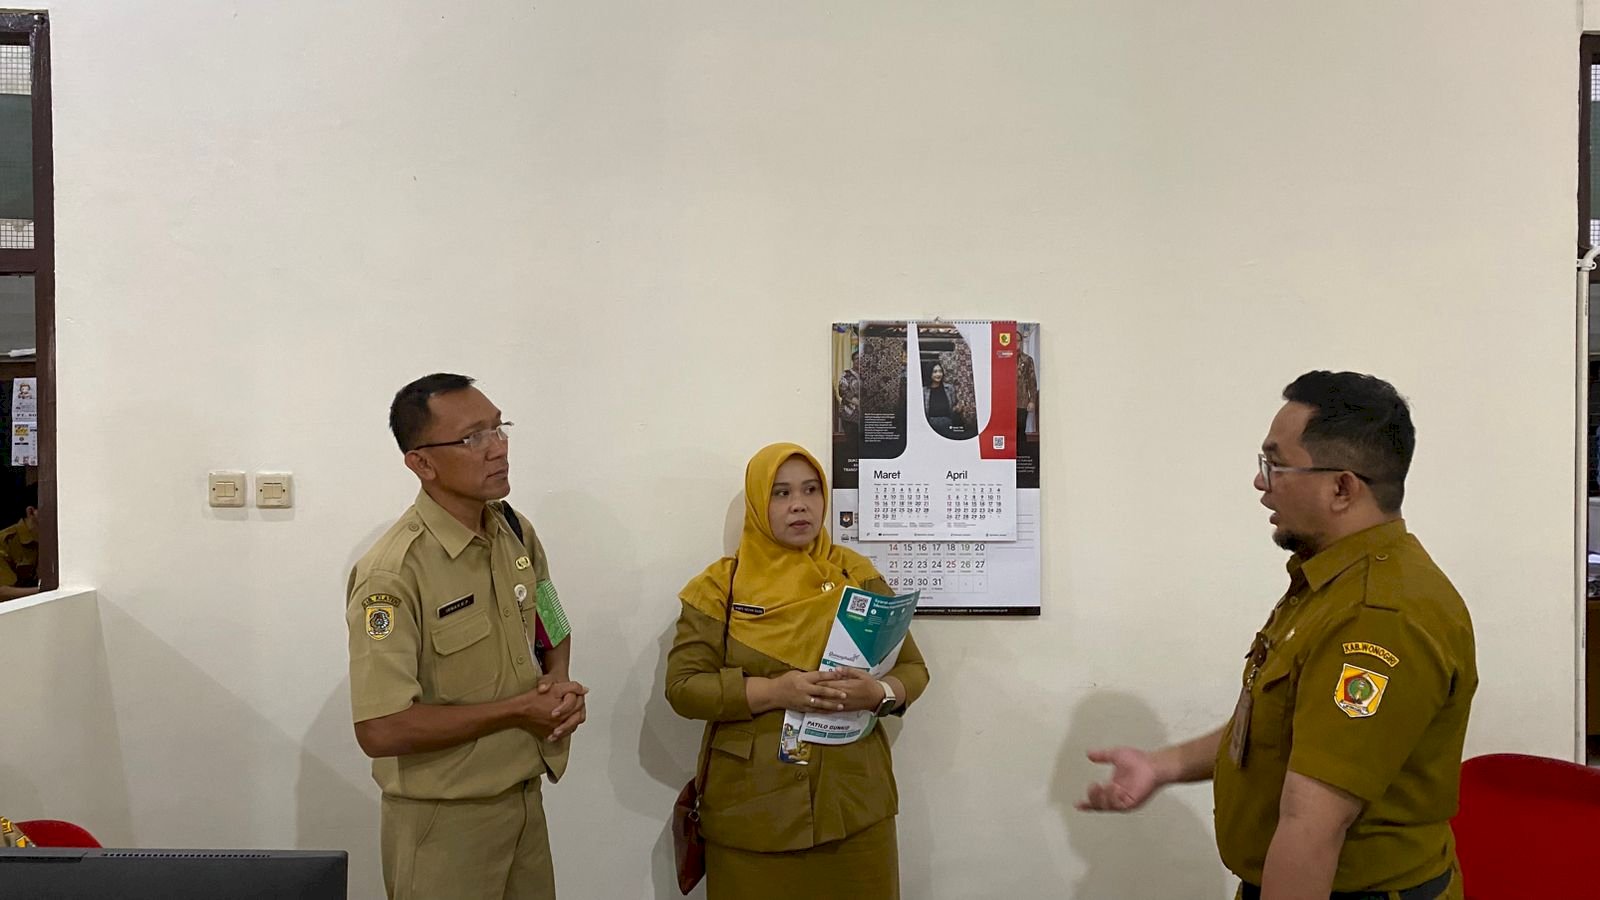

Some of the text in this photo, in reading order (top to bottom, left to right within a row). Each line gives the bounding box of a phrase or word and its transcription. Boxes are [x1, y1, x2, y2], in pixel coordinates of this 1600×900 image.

[874, 470, 901, 479] Maret
[946, 470, 968, 481] April
[889, 543, 985, 551] 14 15 16 17 18 19 20
[889, 560, 985, 569] 21 22 23 24 25 26 27
[889, 578, 942, 586] 28 29 30 31
[807, 721, 828, 730] PATILO
